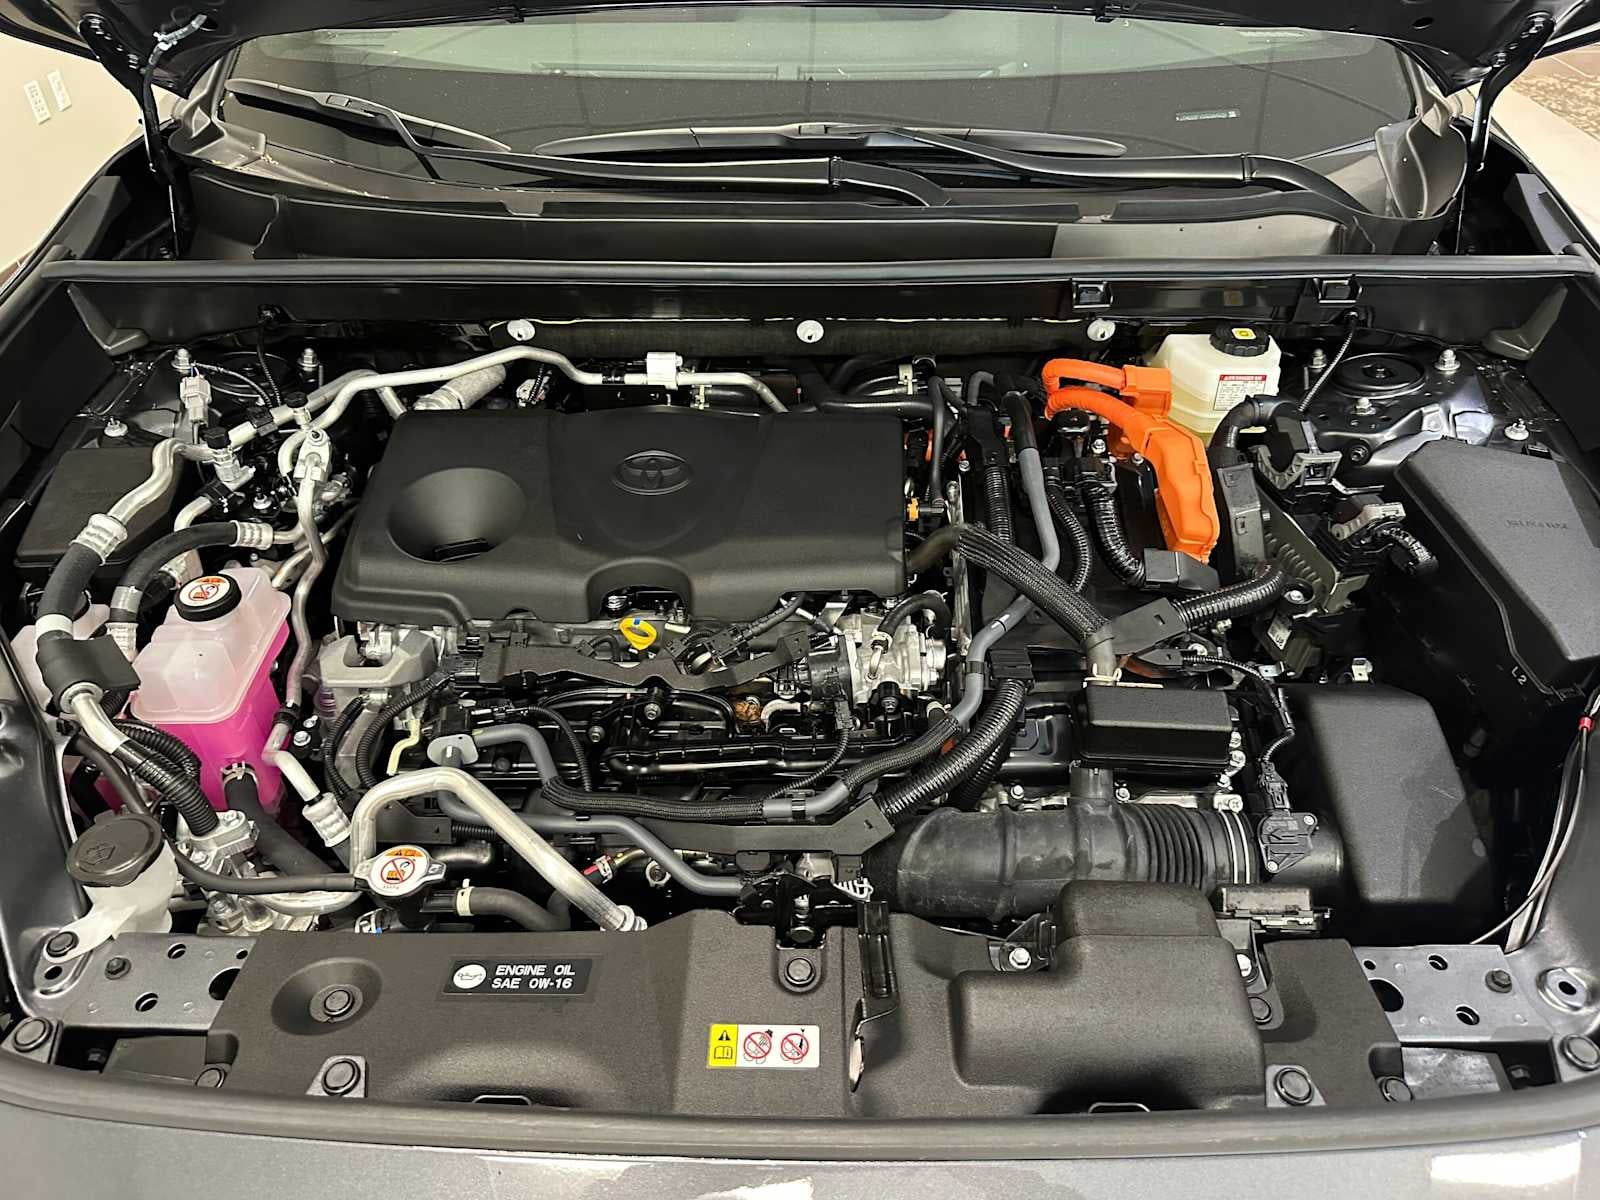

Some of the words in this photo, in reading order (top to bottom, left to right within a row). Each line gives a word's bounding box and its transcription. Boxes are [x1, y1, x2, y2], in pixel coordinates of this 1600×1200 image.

[495, 964, 547, 976] ENGINE
[553, 964, 575, 976] OIL
[491, 977, 522, 989] SAE
[528, 977, 573, 989] 0W-16
